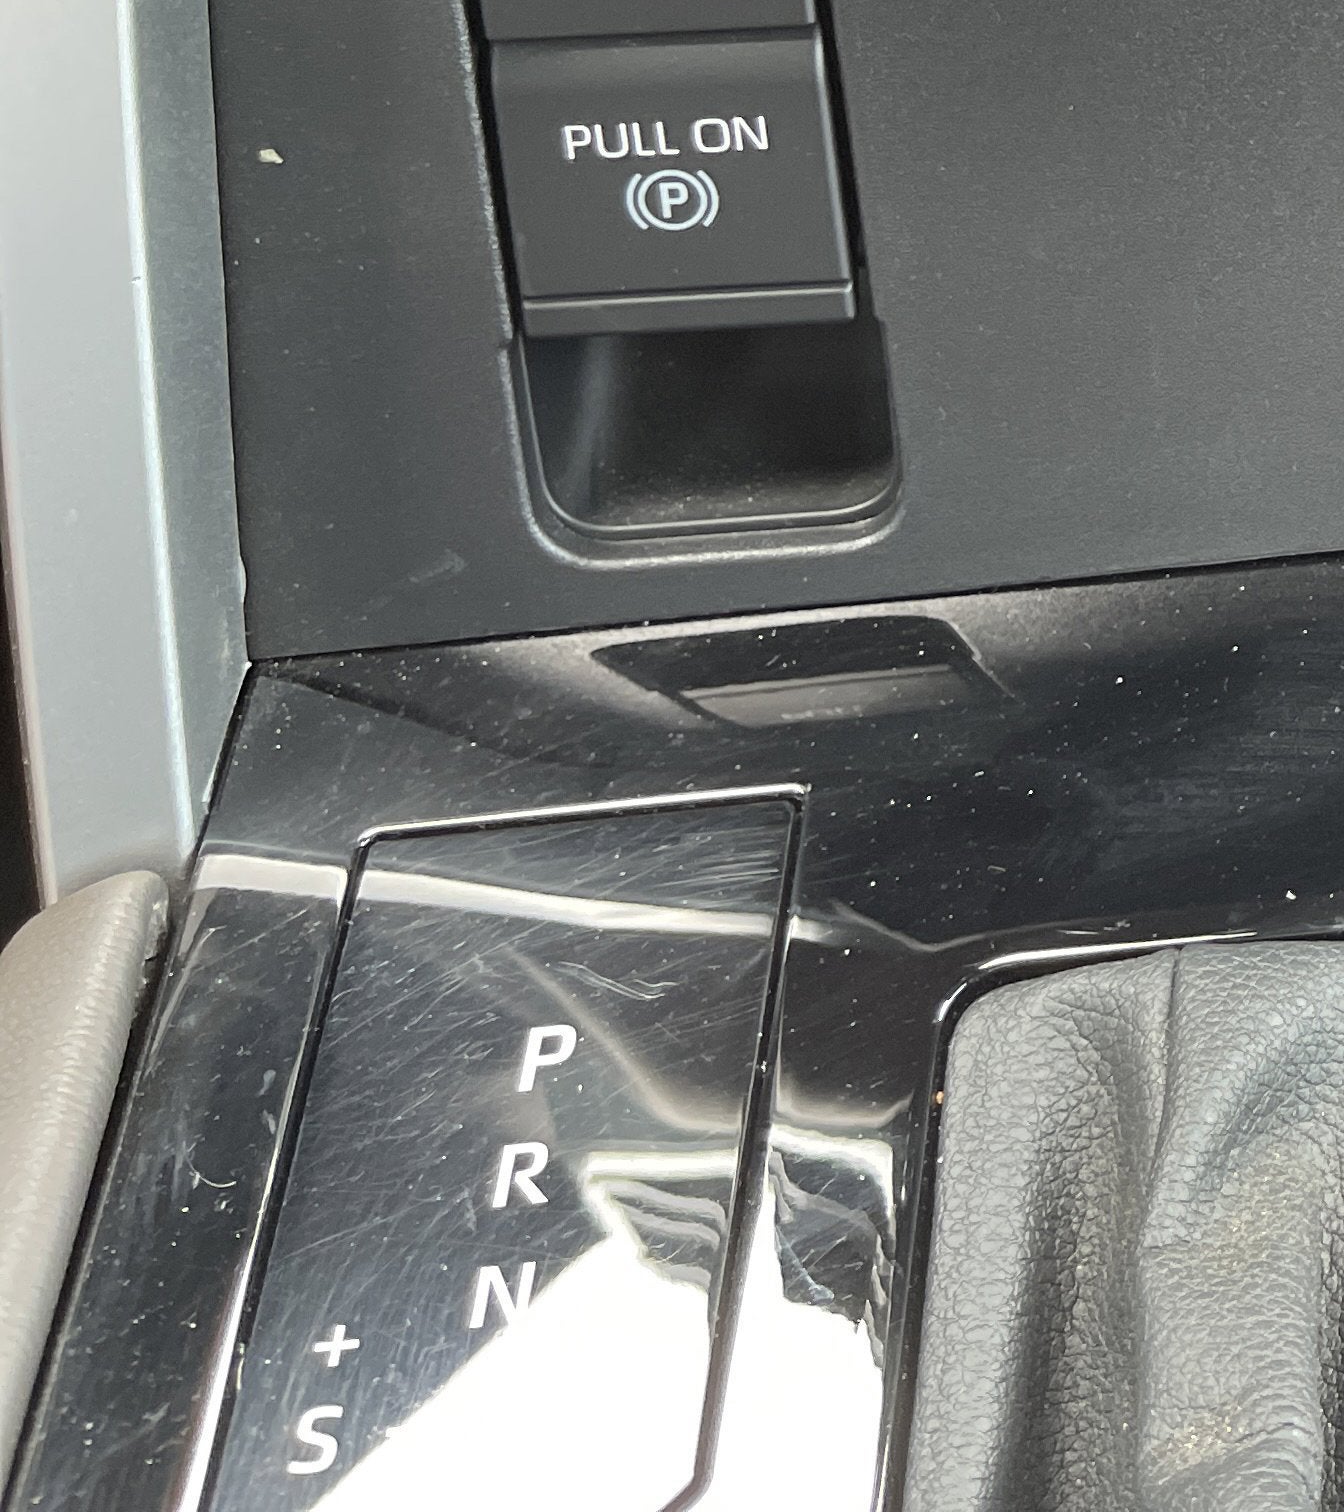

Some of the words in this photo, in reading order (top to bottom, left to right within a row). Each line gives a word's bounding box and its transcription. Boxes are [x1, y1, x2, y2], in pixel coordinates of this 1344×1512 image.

[562, 120, 680, 160] PULL
[693, 115, 769, 155] ON
[657, 181, 689, 219] P
[517, 1024, 577, 1093] P
[491, 1141, 549, 1208] R
[468, 1261, 537, 1330] N
[286, 1405, 344, 1476] S
